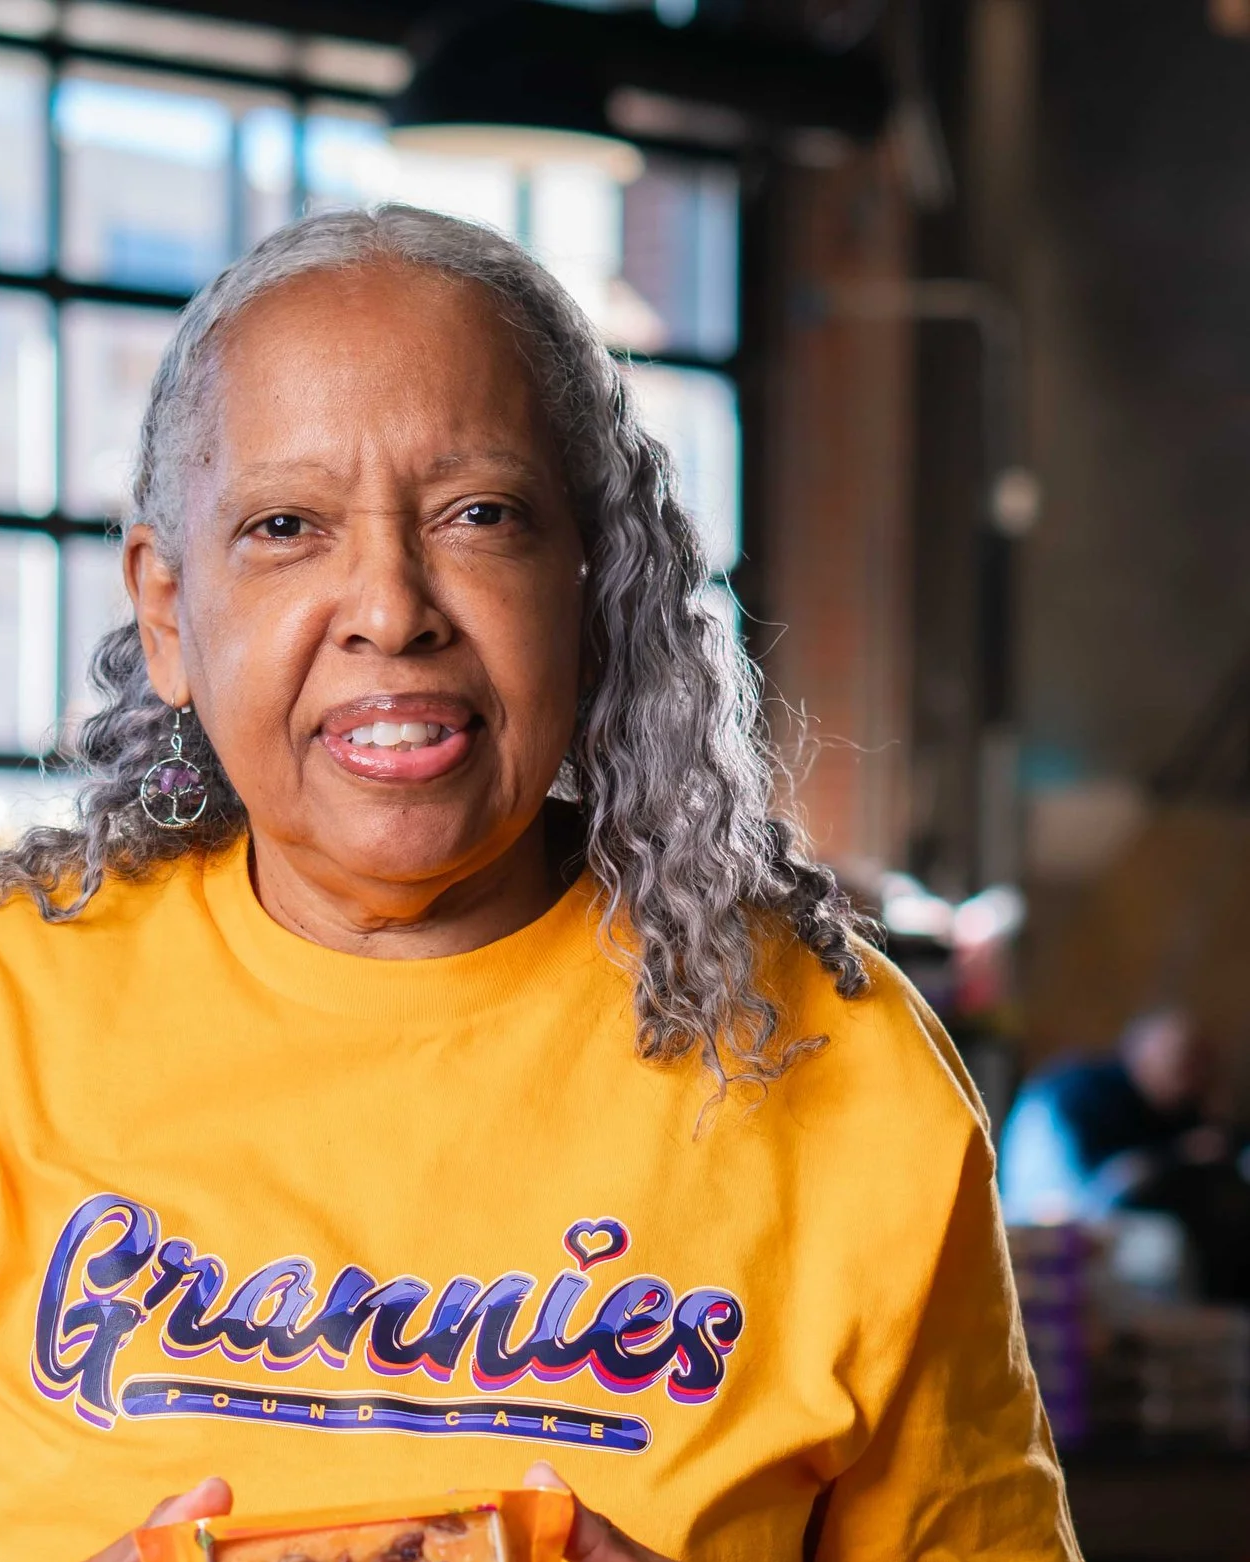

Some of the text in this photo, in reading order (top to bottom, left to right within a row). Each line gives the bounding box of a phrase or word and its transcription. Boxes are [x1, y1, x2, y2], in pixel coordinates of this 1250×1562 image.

[29, 1193, 745, 1430] Grannies
[166, 1389, 605, 1439] POUND CAKE
